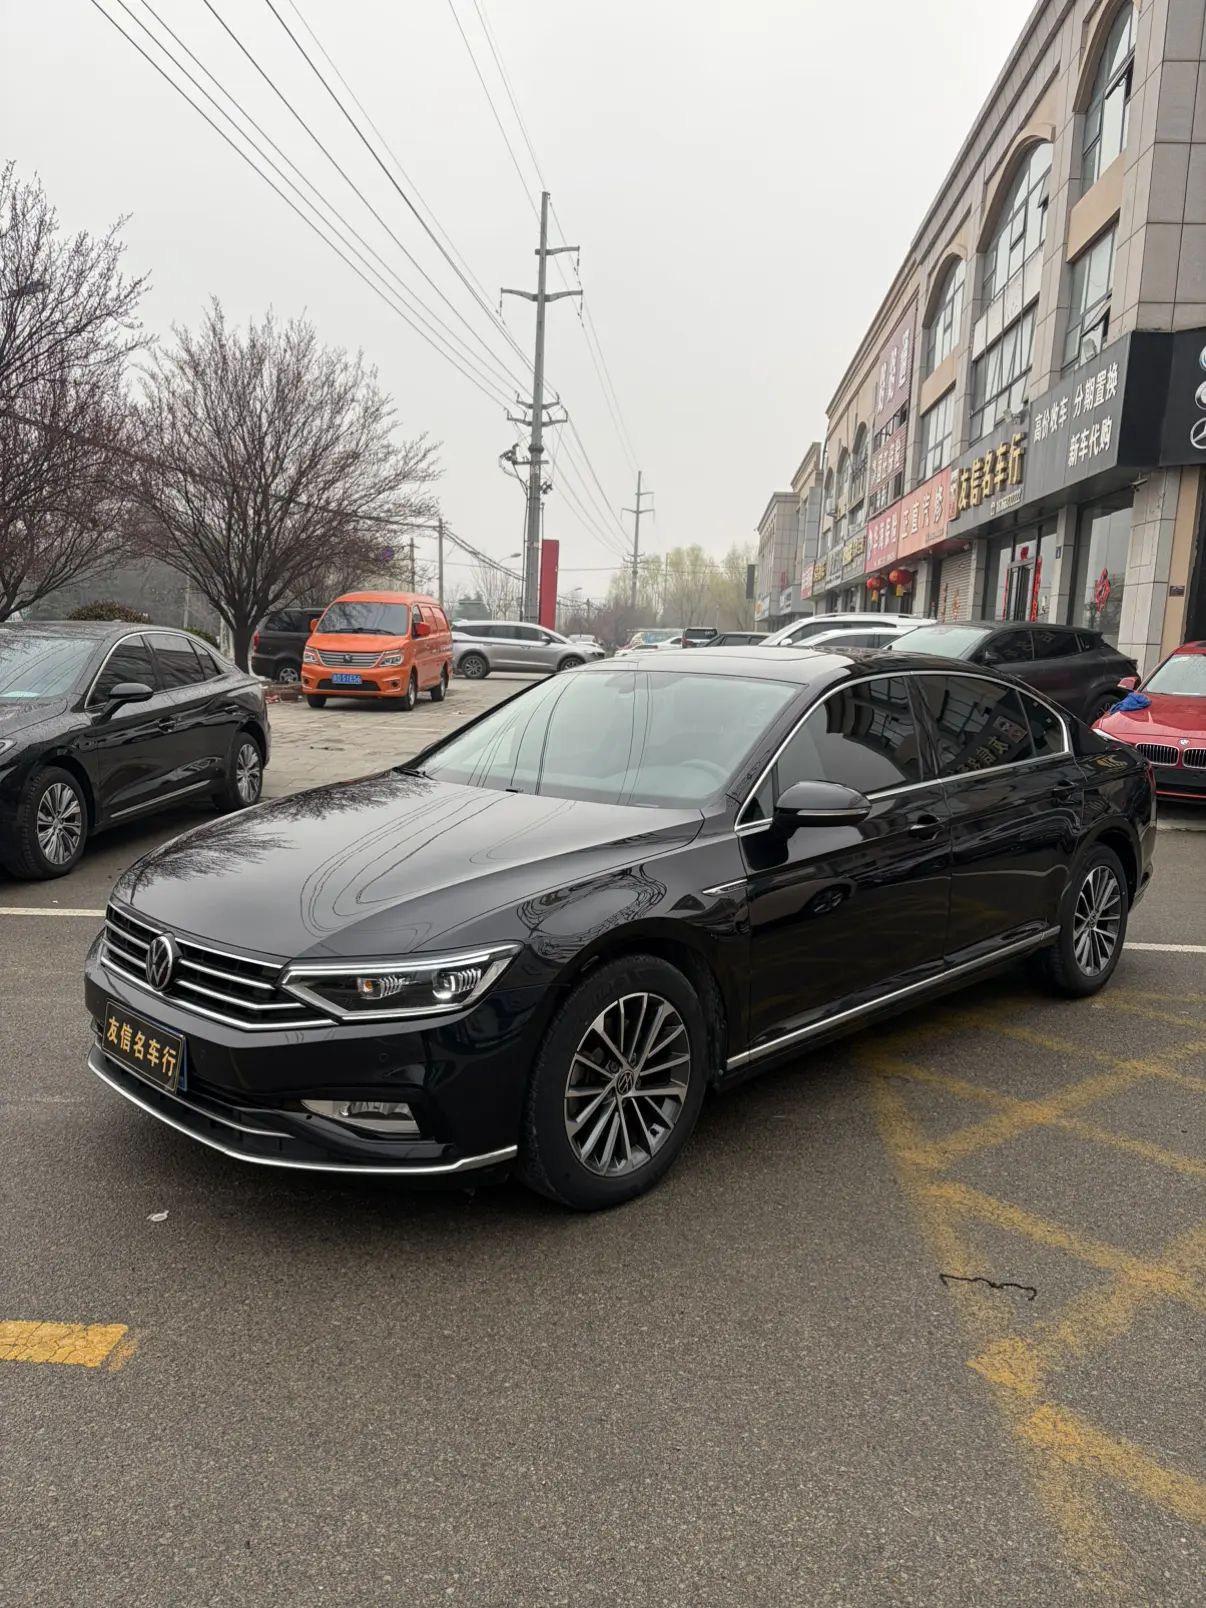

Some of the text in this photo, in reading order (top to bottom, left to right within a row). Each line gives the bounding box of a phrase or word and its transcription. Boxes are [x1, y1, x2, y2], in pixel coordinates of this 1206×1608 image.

[1034, 362, 1118, 443] 高价收车 分期置换
[958, 432, 1026, 511] 友信名车行
[1068, 415, 1112, 468] 新车代购
[106, 1016, 176, 1077] 友信名车行
